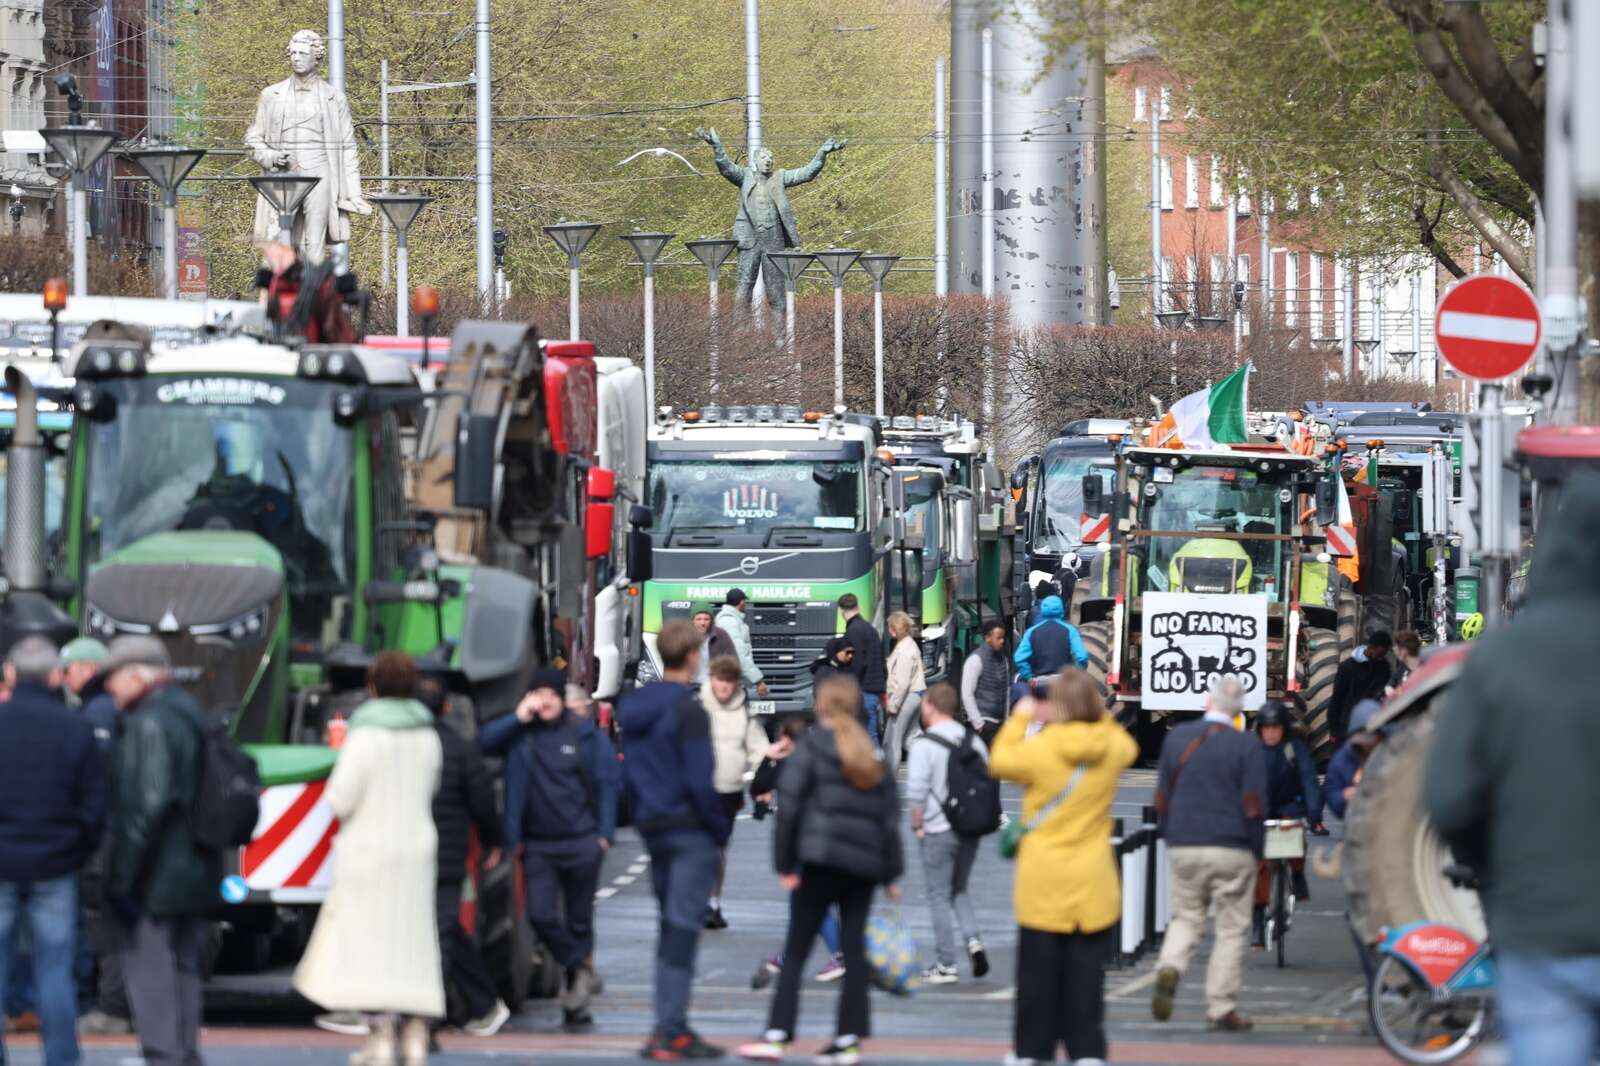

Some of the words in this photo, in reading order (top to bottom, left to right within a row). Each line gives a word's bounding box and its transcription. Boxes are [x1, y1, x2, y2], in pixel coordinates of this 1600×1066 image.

[727, 509, 774, 518] VOLVO
[752, 586, 811, 599] HAULAGE
[1153, 615, 1183, 635] NO
[1188, 614, 1254, 637] FARMS
[1153, 670, 1187, 690] NO
[1193, 670, 1253, 691] FOD
